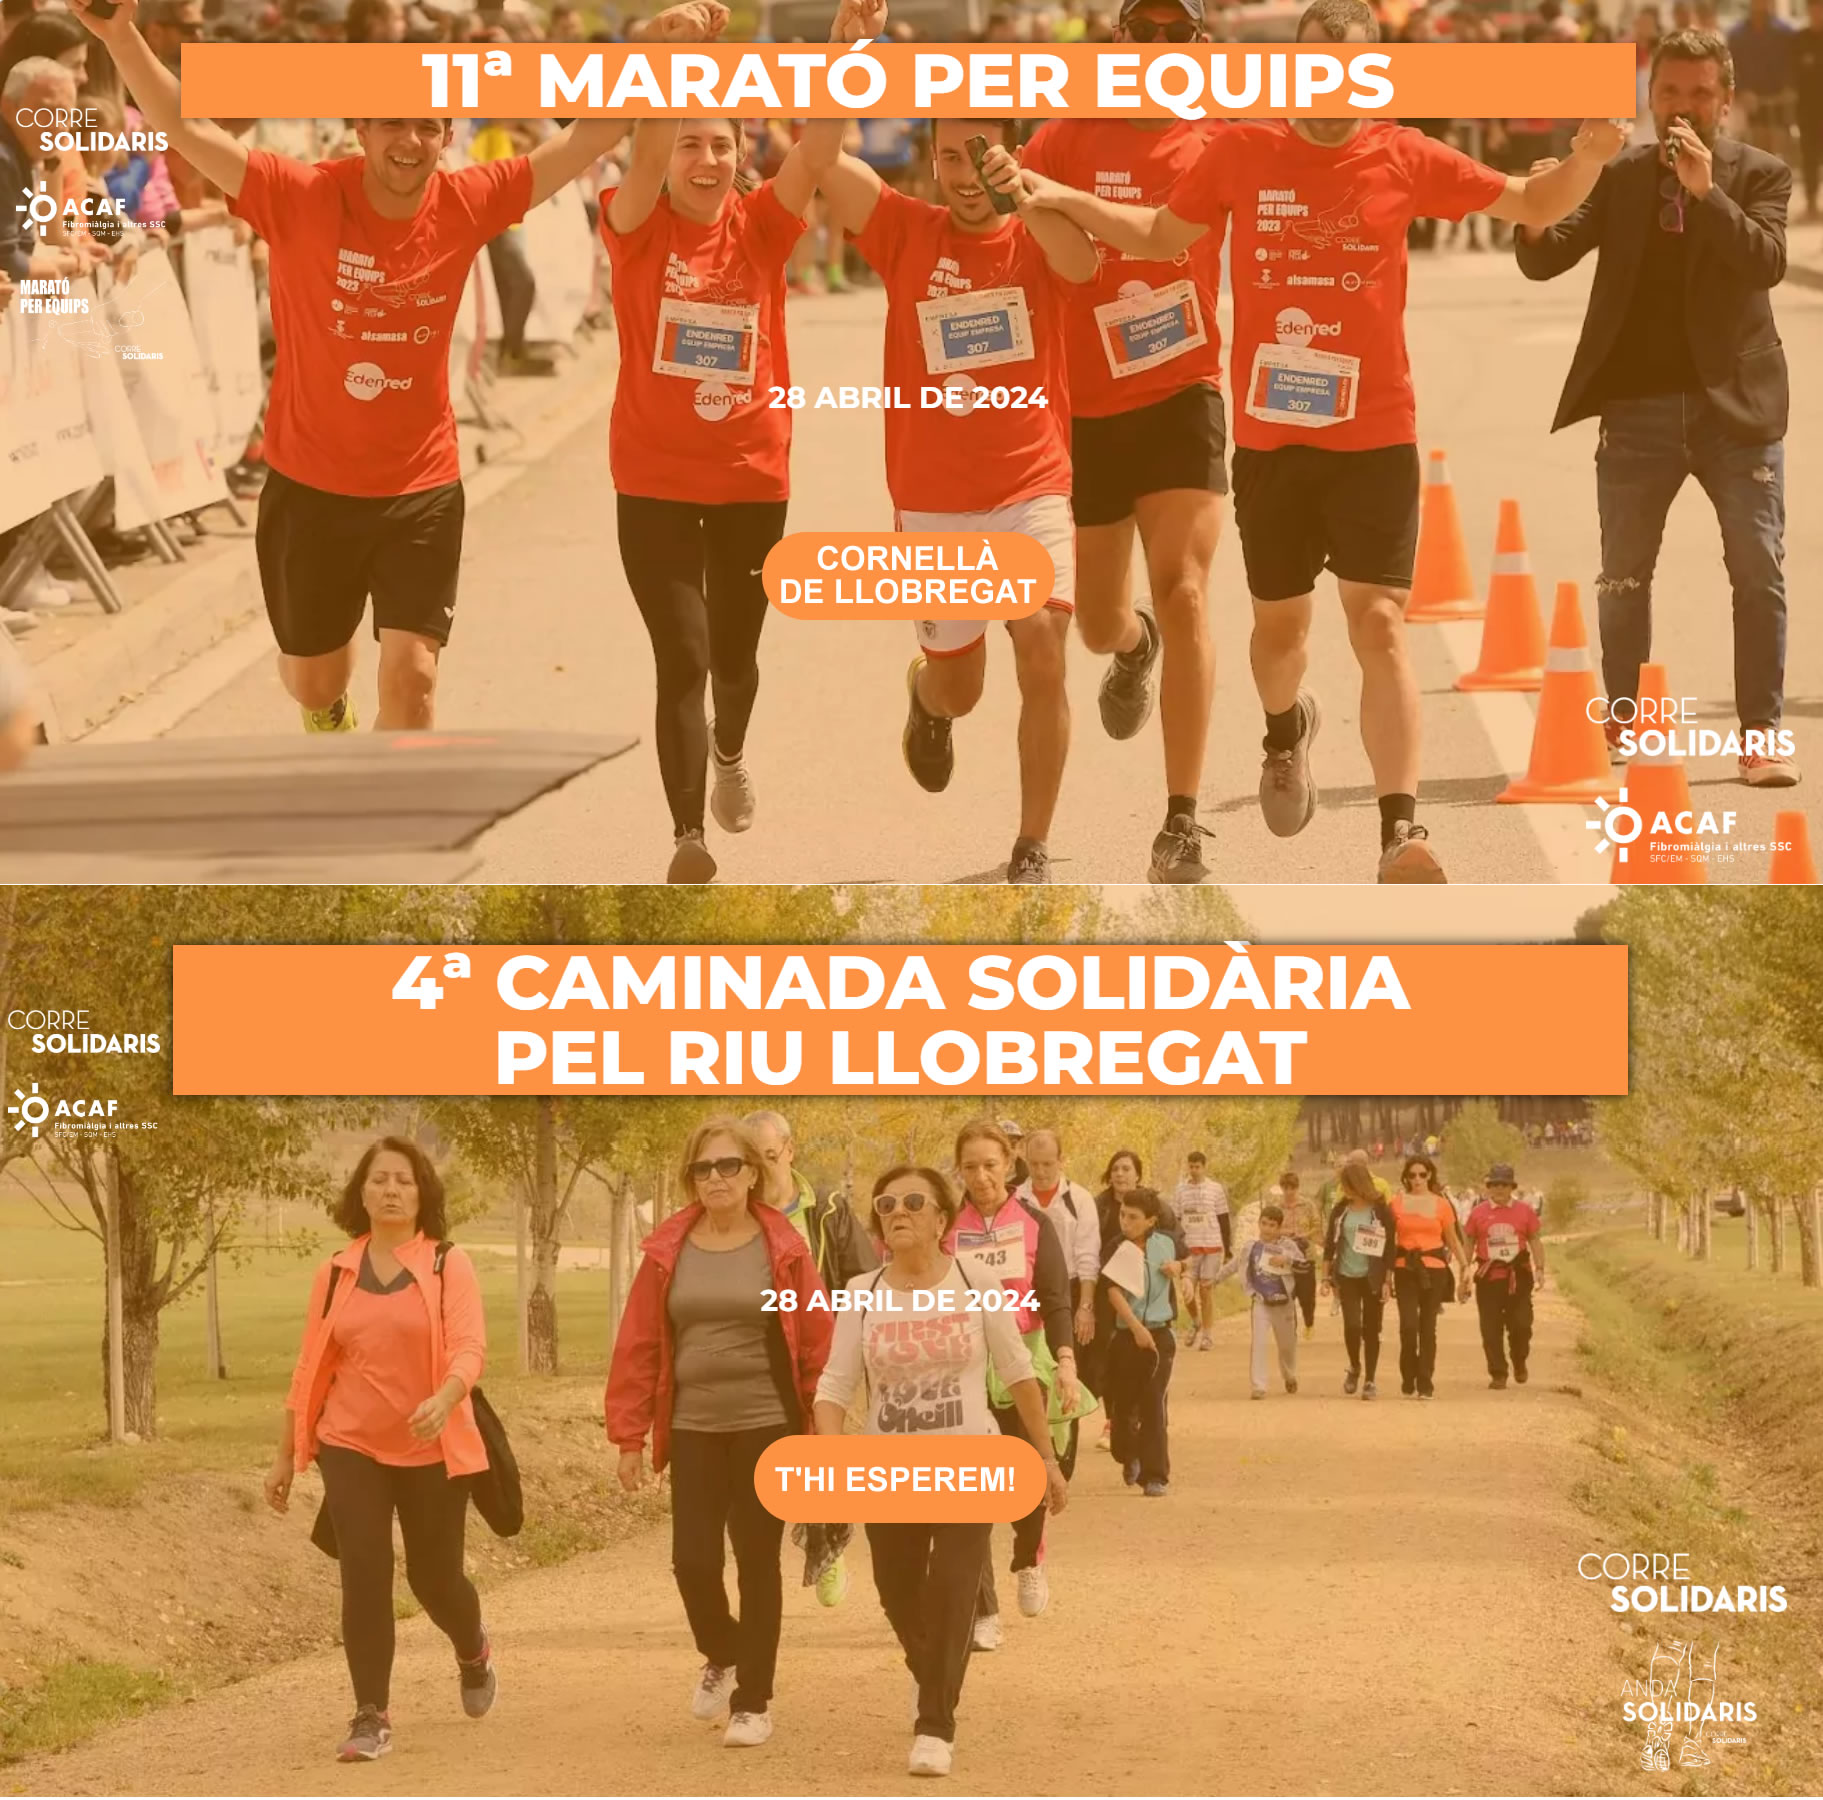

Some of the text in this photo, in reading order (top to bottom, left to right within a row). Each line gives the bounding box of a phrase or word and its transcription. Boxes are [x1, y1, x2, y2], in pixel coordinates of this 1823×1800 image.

[1095, 185, 1142, 199] PER EQUIPS
[1258, 189, 1296, 202] MARATÓ
[1257, 203, 1309, 217] PER EQUIPS
[1257, 219, 1281, 232] 2023
[353, 267, 385, 284] EQUIPS
[1286, 275, 1335, 286] alsamasa
[950, 315, 1000, 331] ENDENRED
[1275, 320, 1342, 336] Edenred
[685, 329, 735, 343] ENDENRED
[967, 341, 990, 355] 307
[1147, 337, 1168, 353] 307
[695, 354, 718, 367] 307
[345, 370, 413, 390] Edenred
[1278, 373, 1329, 387] ENDENRED
[695, 388, 752, 406] Edenred
[1287, 399, 1312, 412] 307
